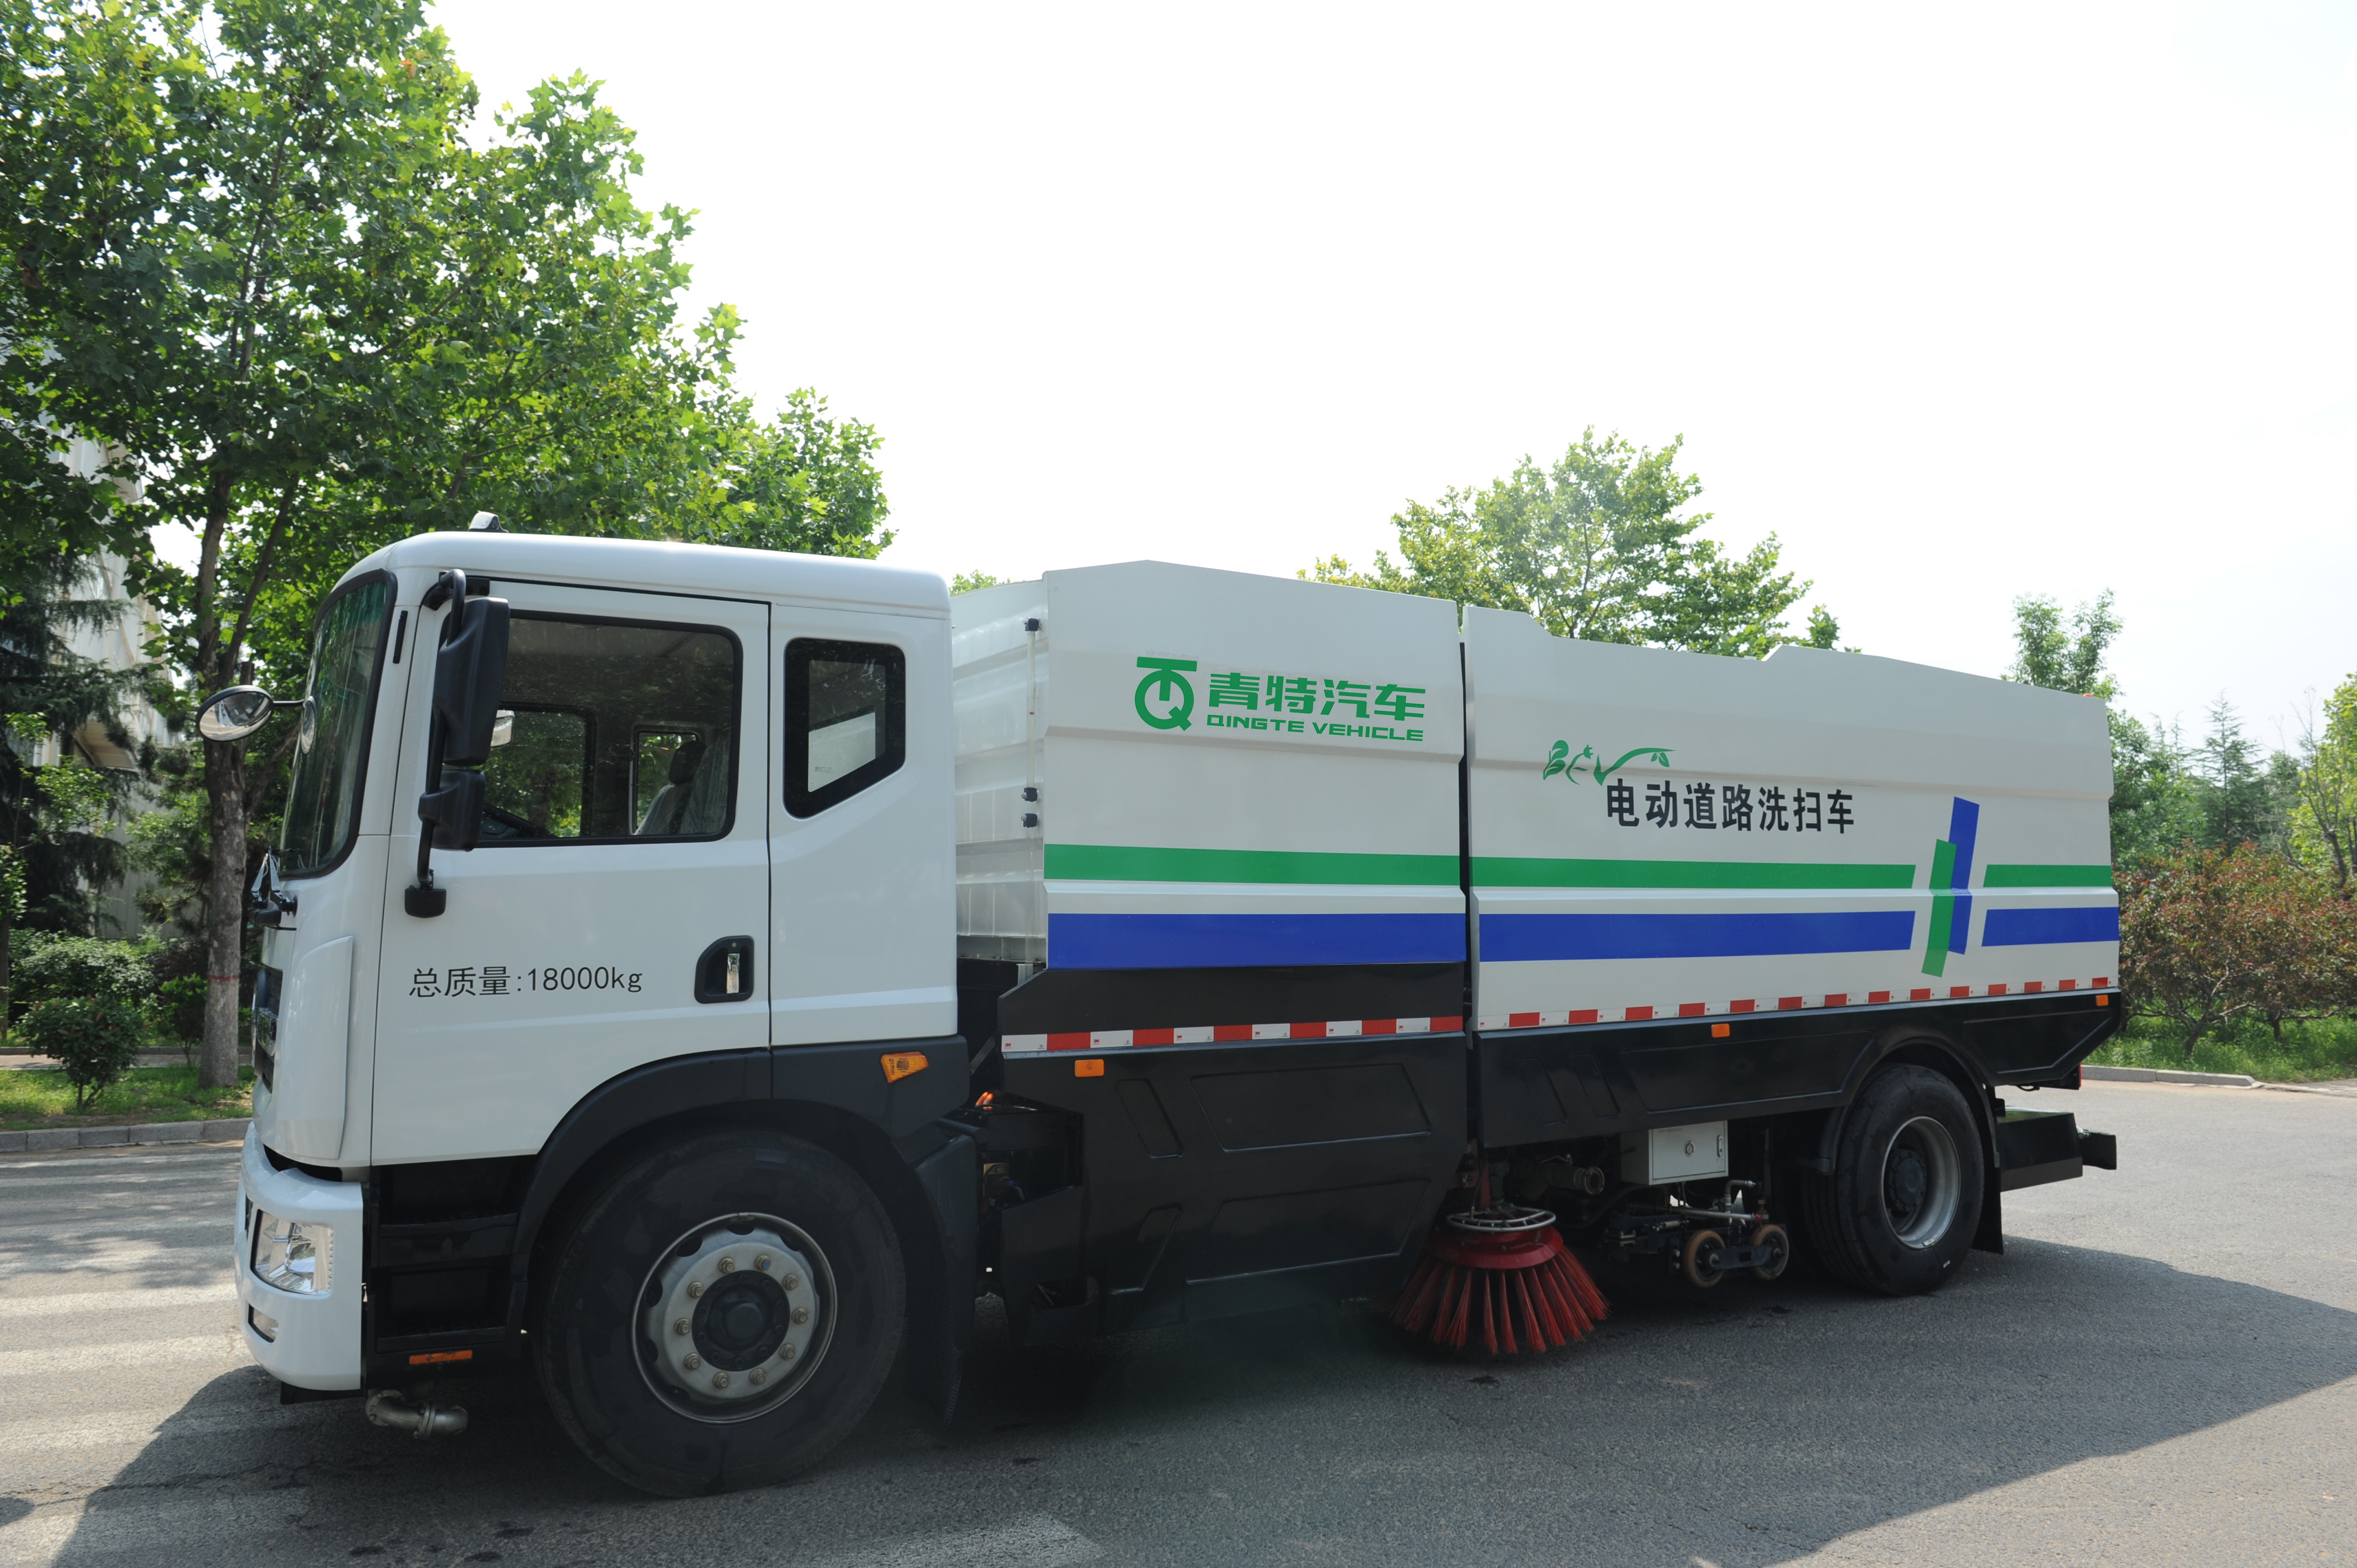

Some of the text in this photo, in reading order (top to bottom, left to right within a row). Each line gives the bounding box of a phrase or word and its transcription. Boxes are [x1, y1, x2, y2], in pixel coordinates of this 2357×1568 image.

[1208, 672, 1427, 722] 青特汽车
[1206, 714, 1424, 742] QINGTE VEHICLE
[1607, 777, 1855, 834] 电动道路洗扫车
[408, 966, 643, 998] 总质量:18000kg
